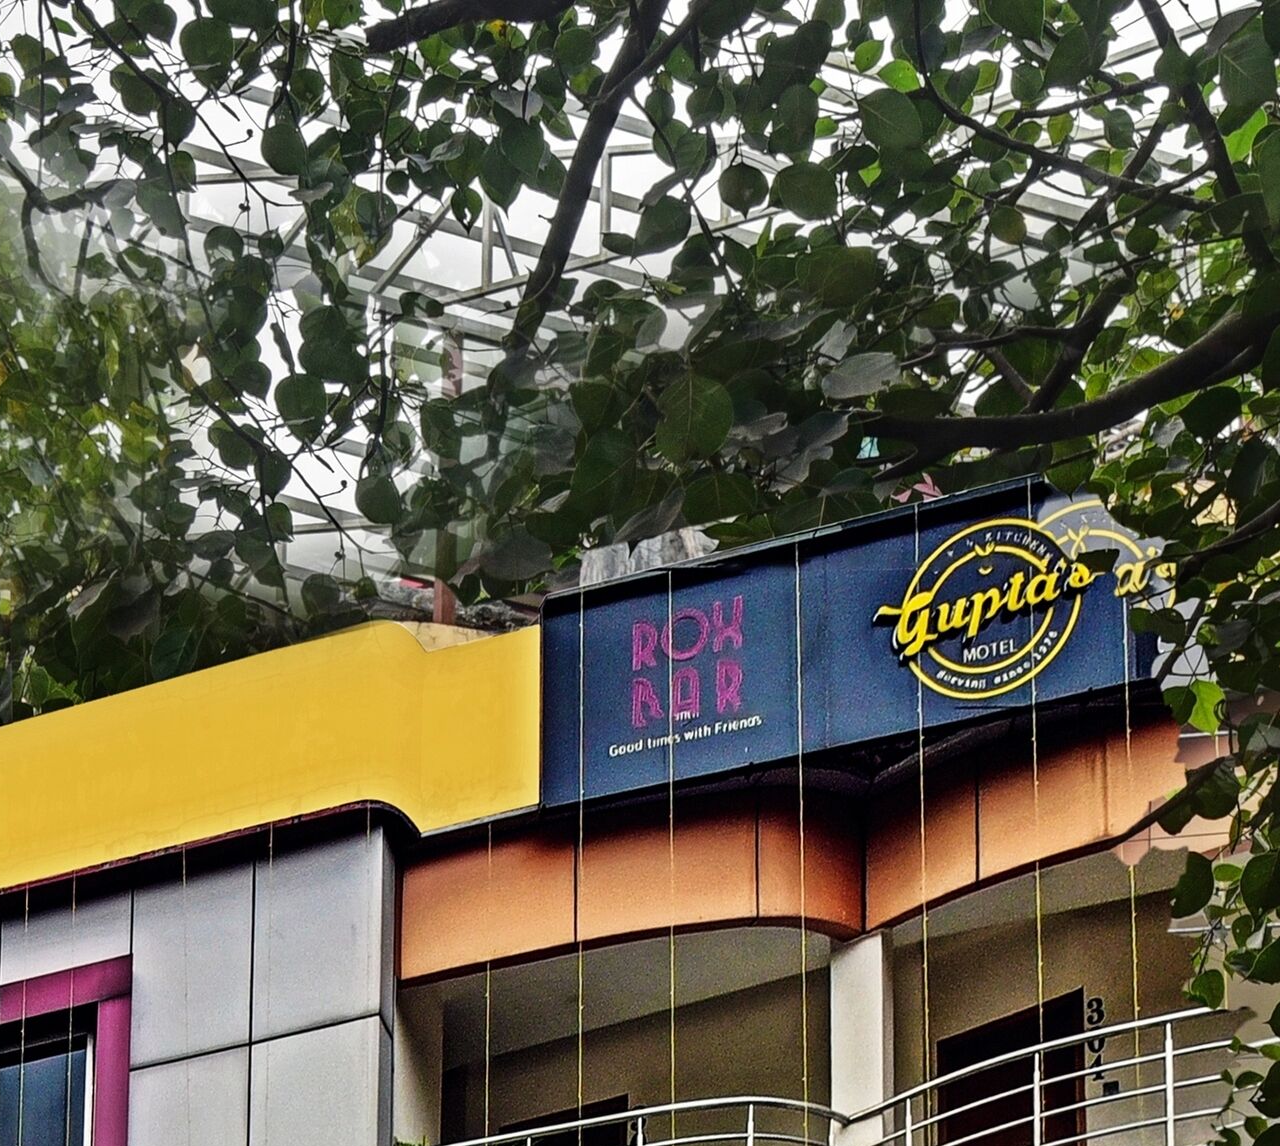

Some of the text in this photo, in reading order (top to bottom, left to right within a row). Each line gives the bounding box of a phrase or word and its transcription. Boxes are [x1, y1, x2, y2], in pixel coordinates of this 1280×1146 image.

[873, 559, 1097, 661] Gupta's
[963, 638, 1019, 663] MOTEL
[609, 738, 643, 757] Good
[684, 724, 712, 742] with
[715, 714, 762, 735] Friends
